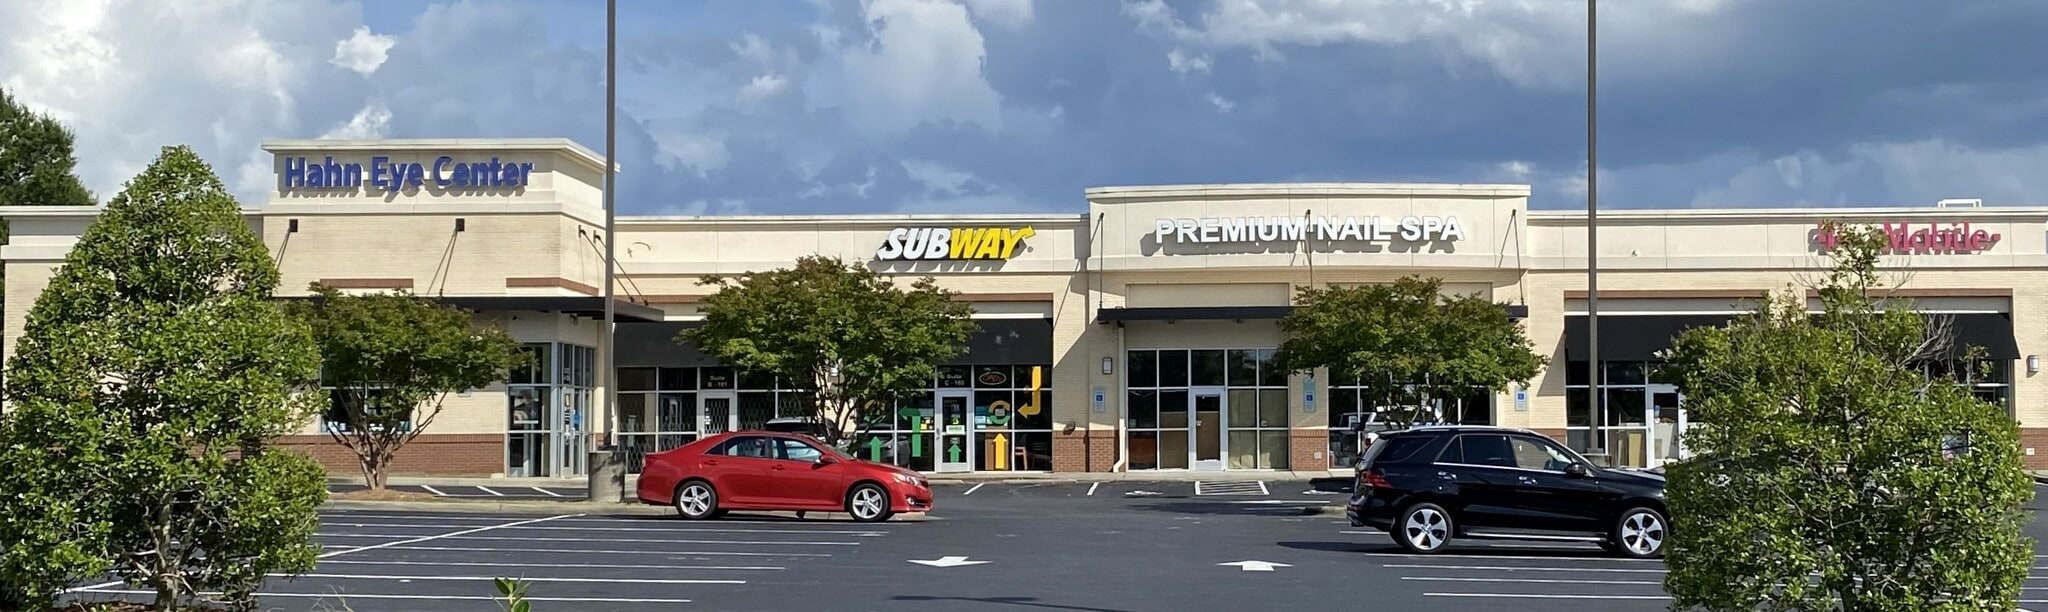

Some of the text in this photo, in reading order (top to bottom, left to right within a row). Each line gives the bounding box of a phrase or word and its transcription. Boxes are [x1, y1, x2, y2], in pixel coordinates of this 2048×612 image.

[285, 156, 533, 192] Hahn Eye Center
[876, 225, 1036, 261] SUBWAY
[1155, 215, 1465, 244] PREMIUM NAIL SPA
